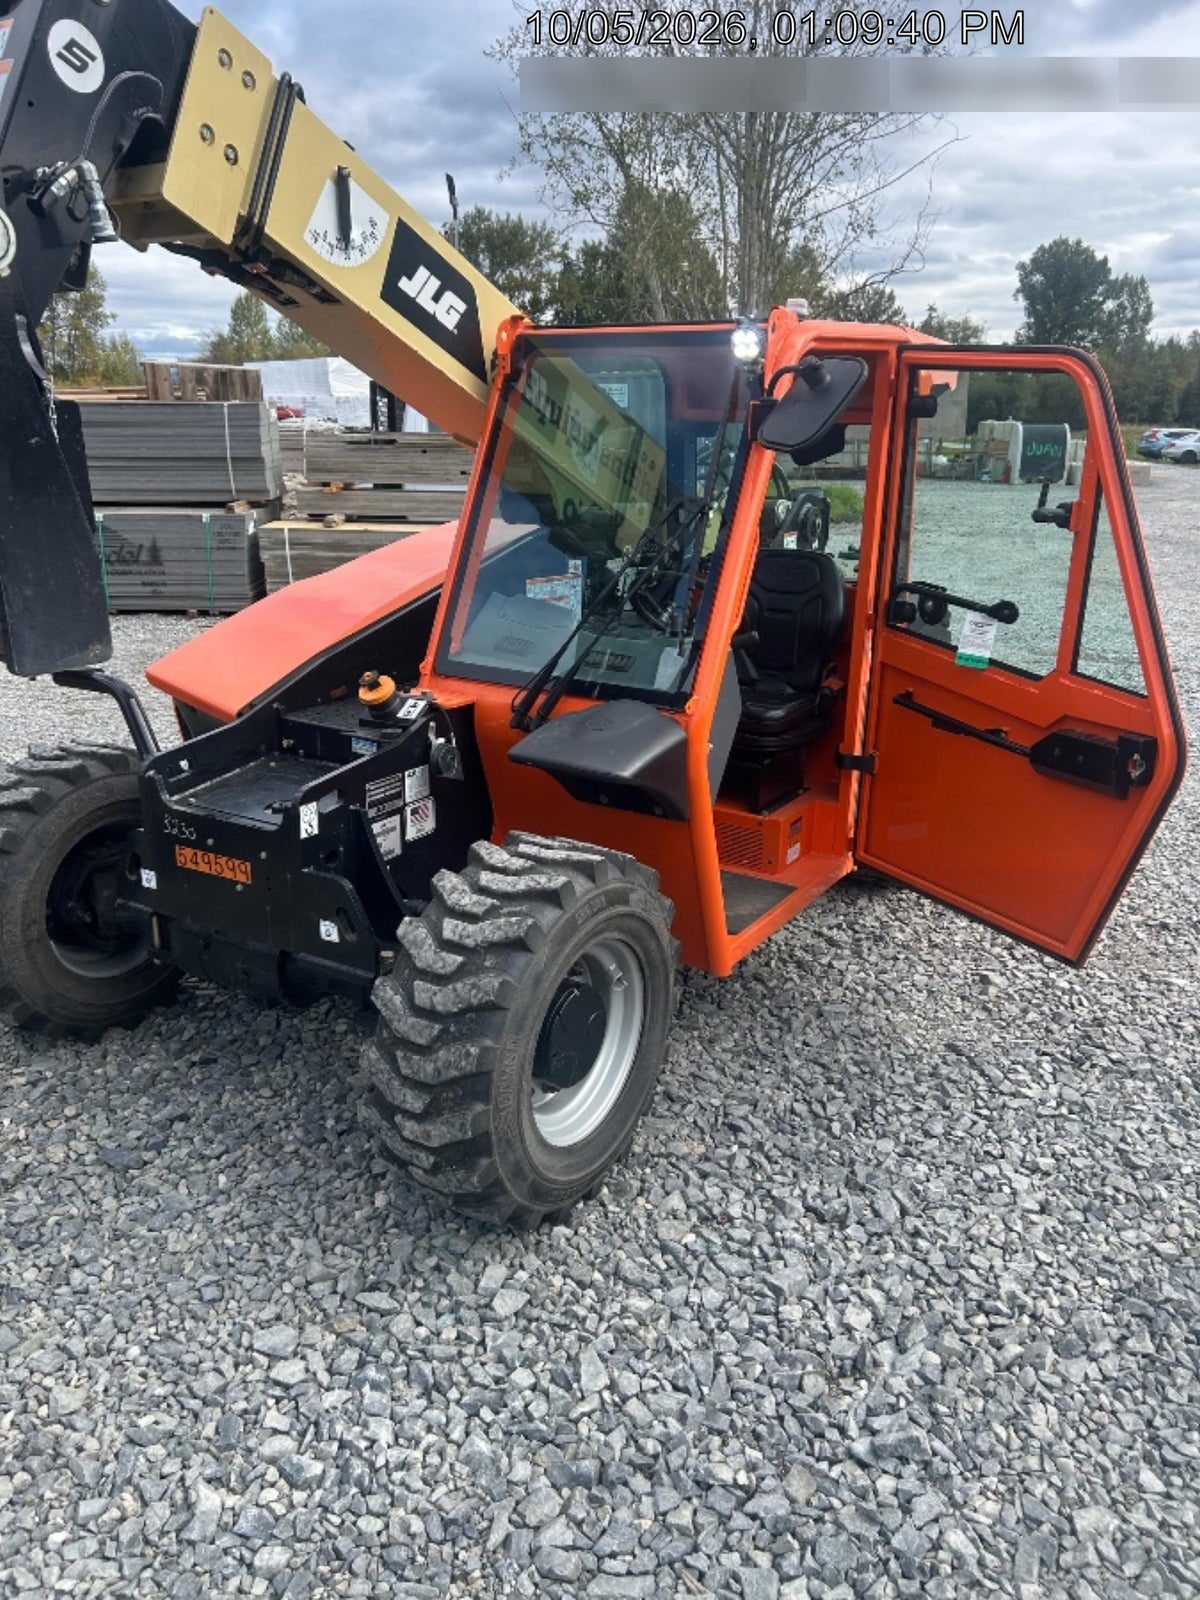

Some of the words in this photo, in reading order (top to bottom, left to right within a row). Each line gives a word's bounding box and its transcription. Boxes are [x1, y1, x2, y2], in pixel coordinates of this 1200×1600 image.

[56, 37, 97, 73] 5
[398, 265, 468, 331] JLG
[178, 845, 249, 883] 549599
